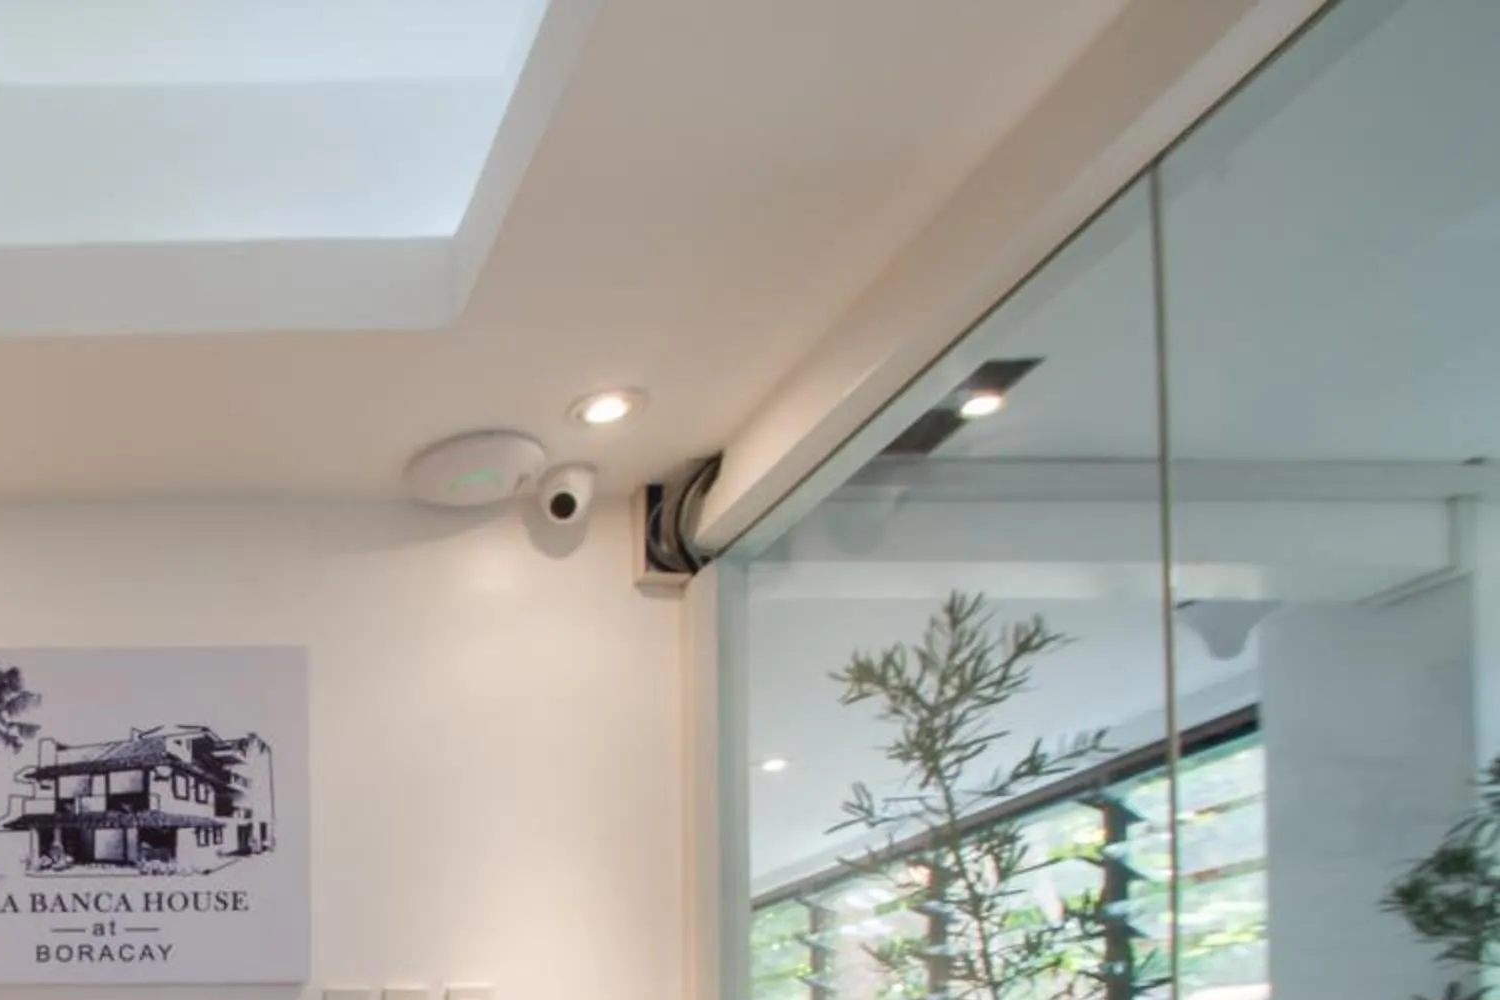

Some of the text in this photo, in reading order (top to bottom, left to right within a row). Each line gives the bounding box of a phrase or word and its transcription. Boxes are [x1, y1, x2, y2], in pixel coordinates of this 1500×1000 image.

[29, 891, 134, 914] BANCA
[142, 890, 250, 913] HOUSE
[92, 920, 117, 937] at
[35, 943, 173, 964] BORACAY
